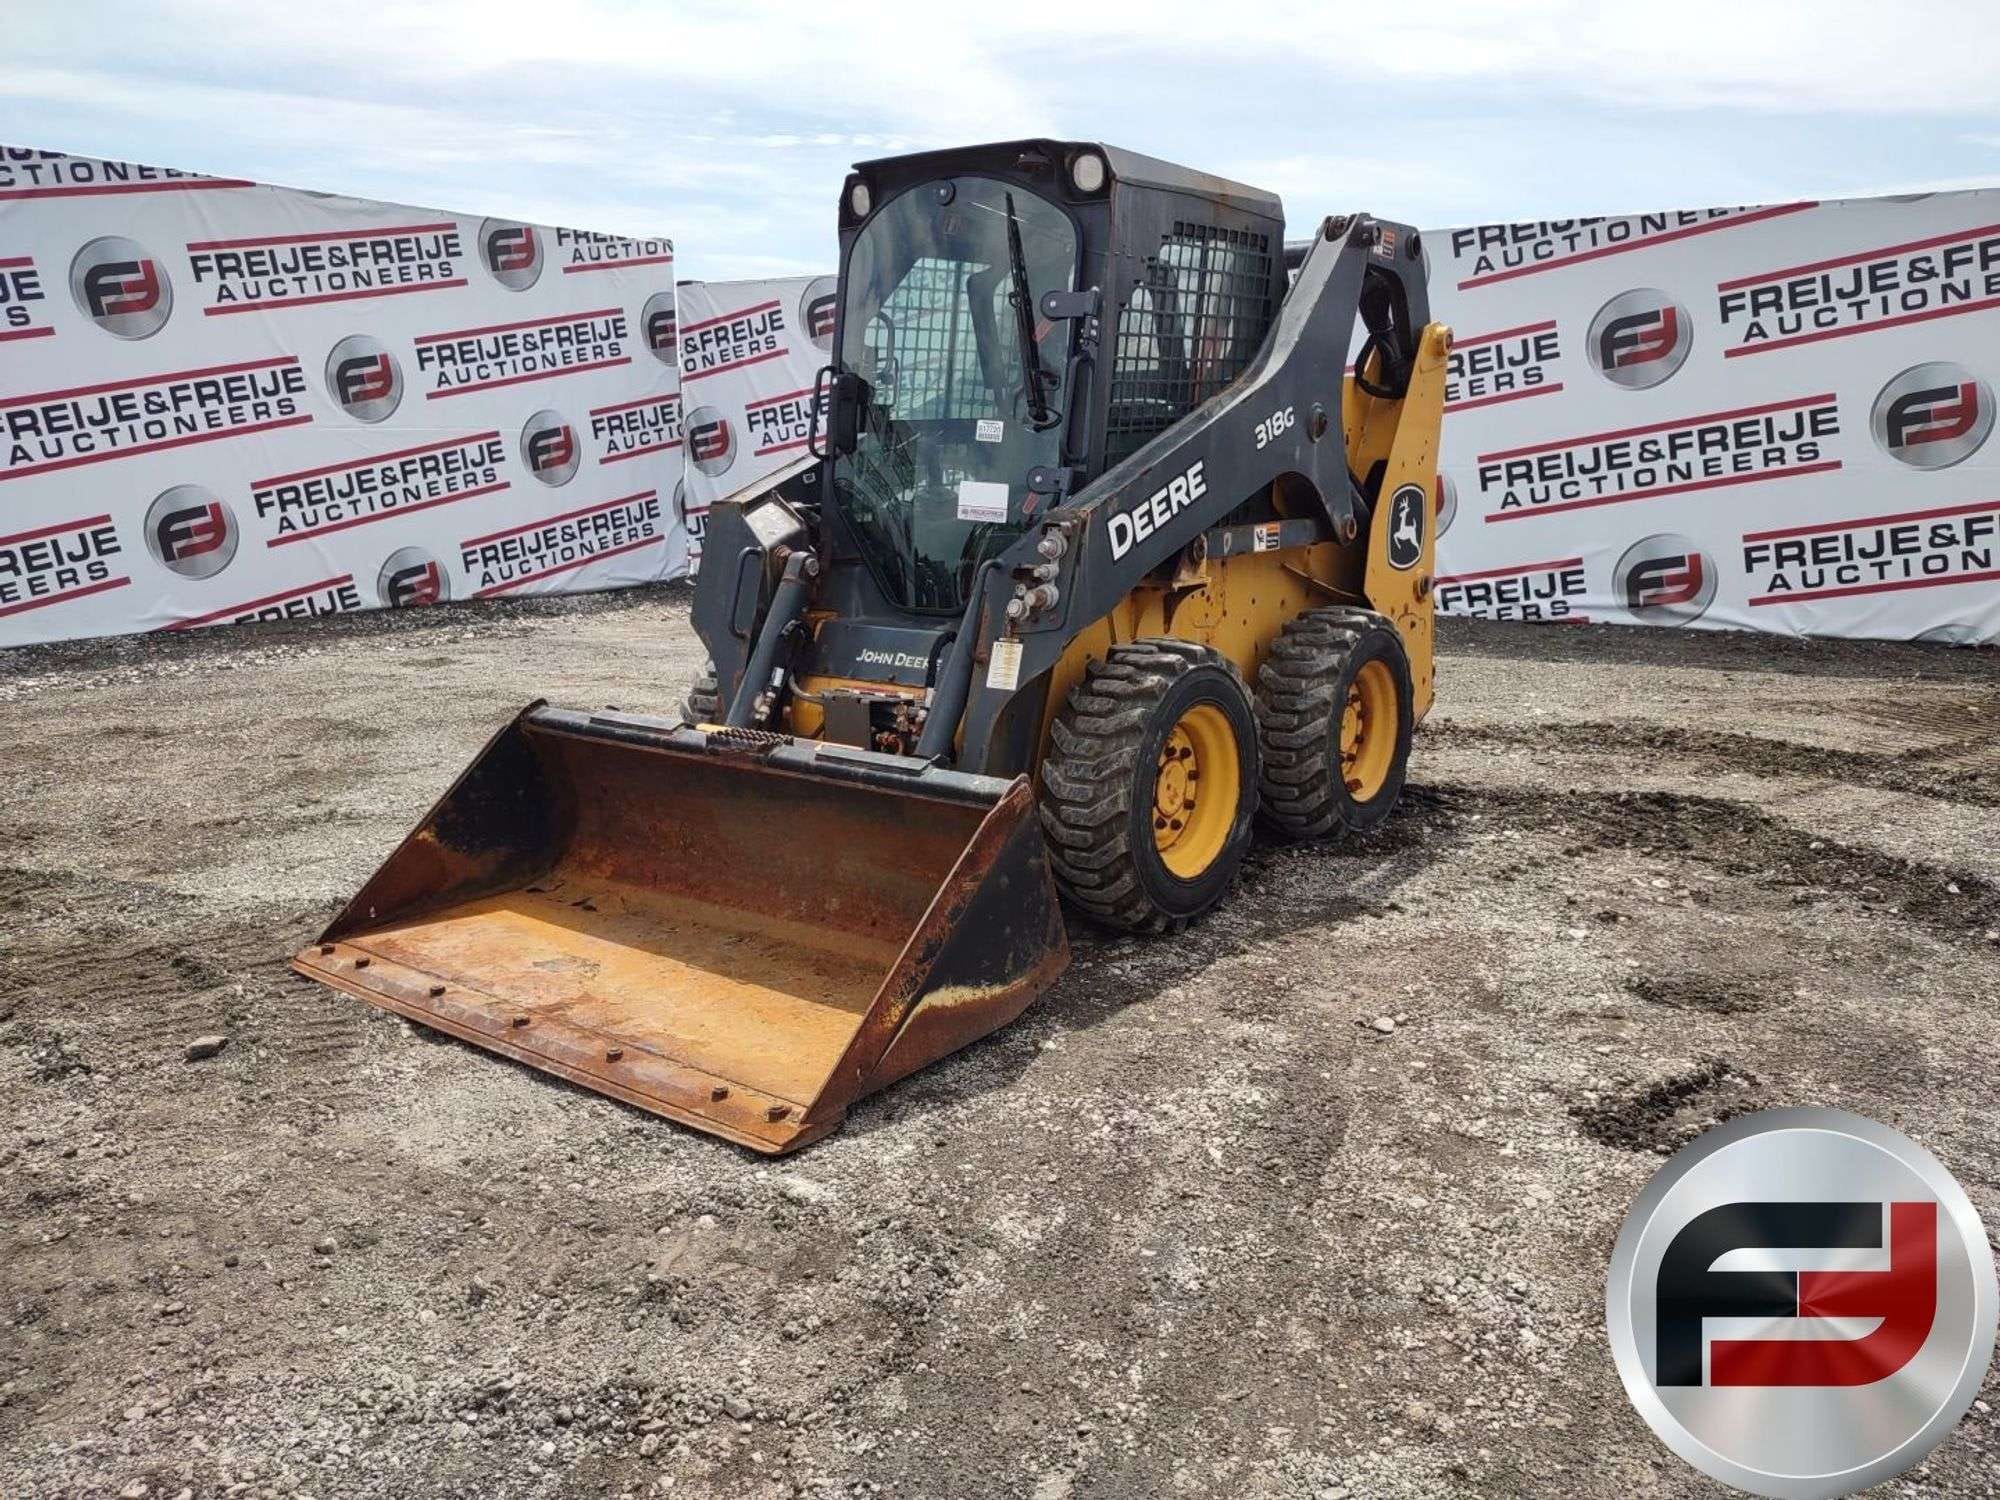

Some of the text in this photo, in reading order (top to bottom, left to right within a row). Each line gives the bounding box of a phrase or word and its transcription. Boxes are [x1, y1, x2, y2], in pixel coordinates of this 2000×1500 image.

[190, 233, 463, 283] FREIJE&FREIJE
[216, 261, 454, 303] AUCTIONEERS
[416, 318, 628, 371] FREIJE&FREIJE
[437, 342, 622, 388] AUCTIONEERS
[684, 335, 777, 372] ONEERS
[1445, 366, 1544, 402] EERS
[10, 397, 297, 466] AUCTIONEERS
[1254, 406, 1295, 450] 318G
[1479, 406, 1840, 492] FREIJE&FREIJE
[253, 440, 506, 517] FREIJE&FREIJE
[278, 468, 498, 534] AUCTIONEERS
[1501, 441, 1820, 510] AUCTIONEERS
[461, 498, 661, 573] FREIJE&FREIJE
[1107, 460, 1207, 561] DEERE
[481, 523, 655, 587] AUCTIONEERS
[1767, 549, 1991, 592] AUCTION
[0, 560, 109, 604] EERS
[856, 648, 894, 664] JOHN
